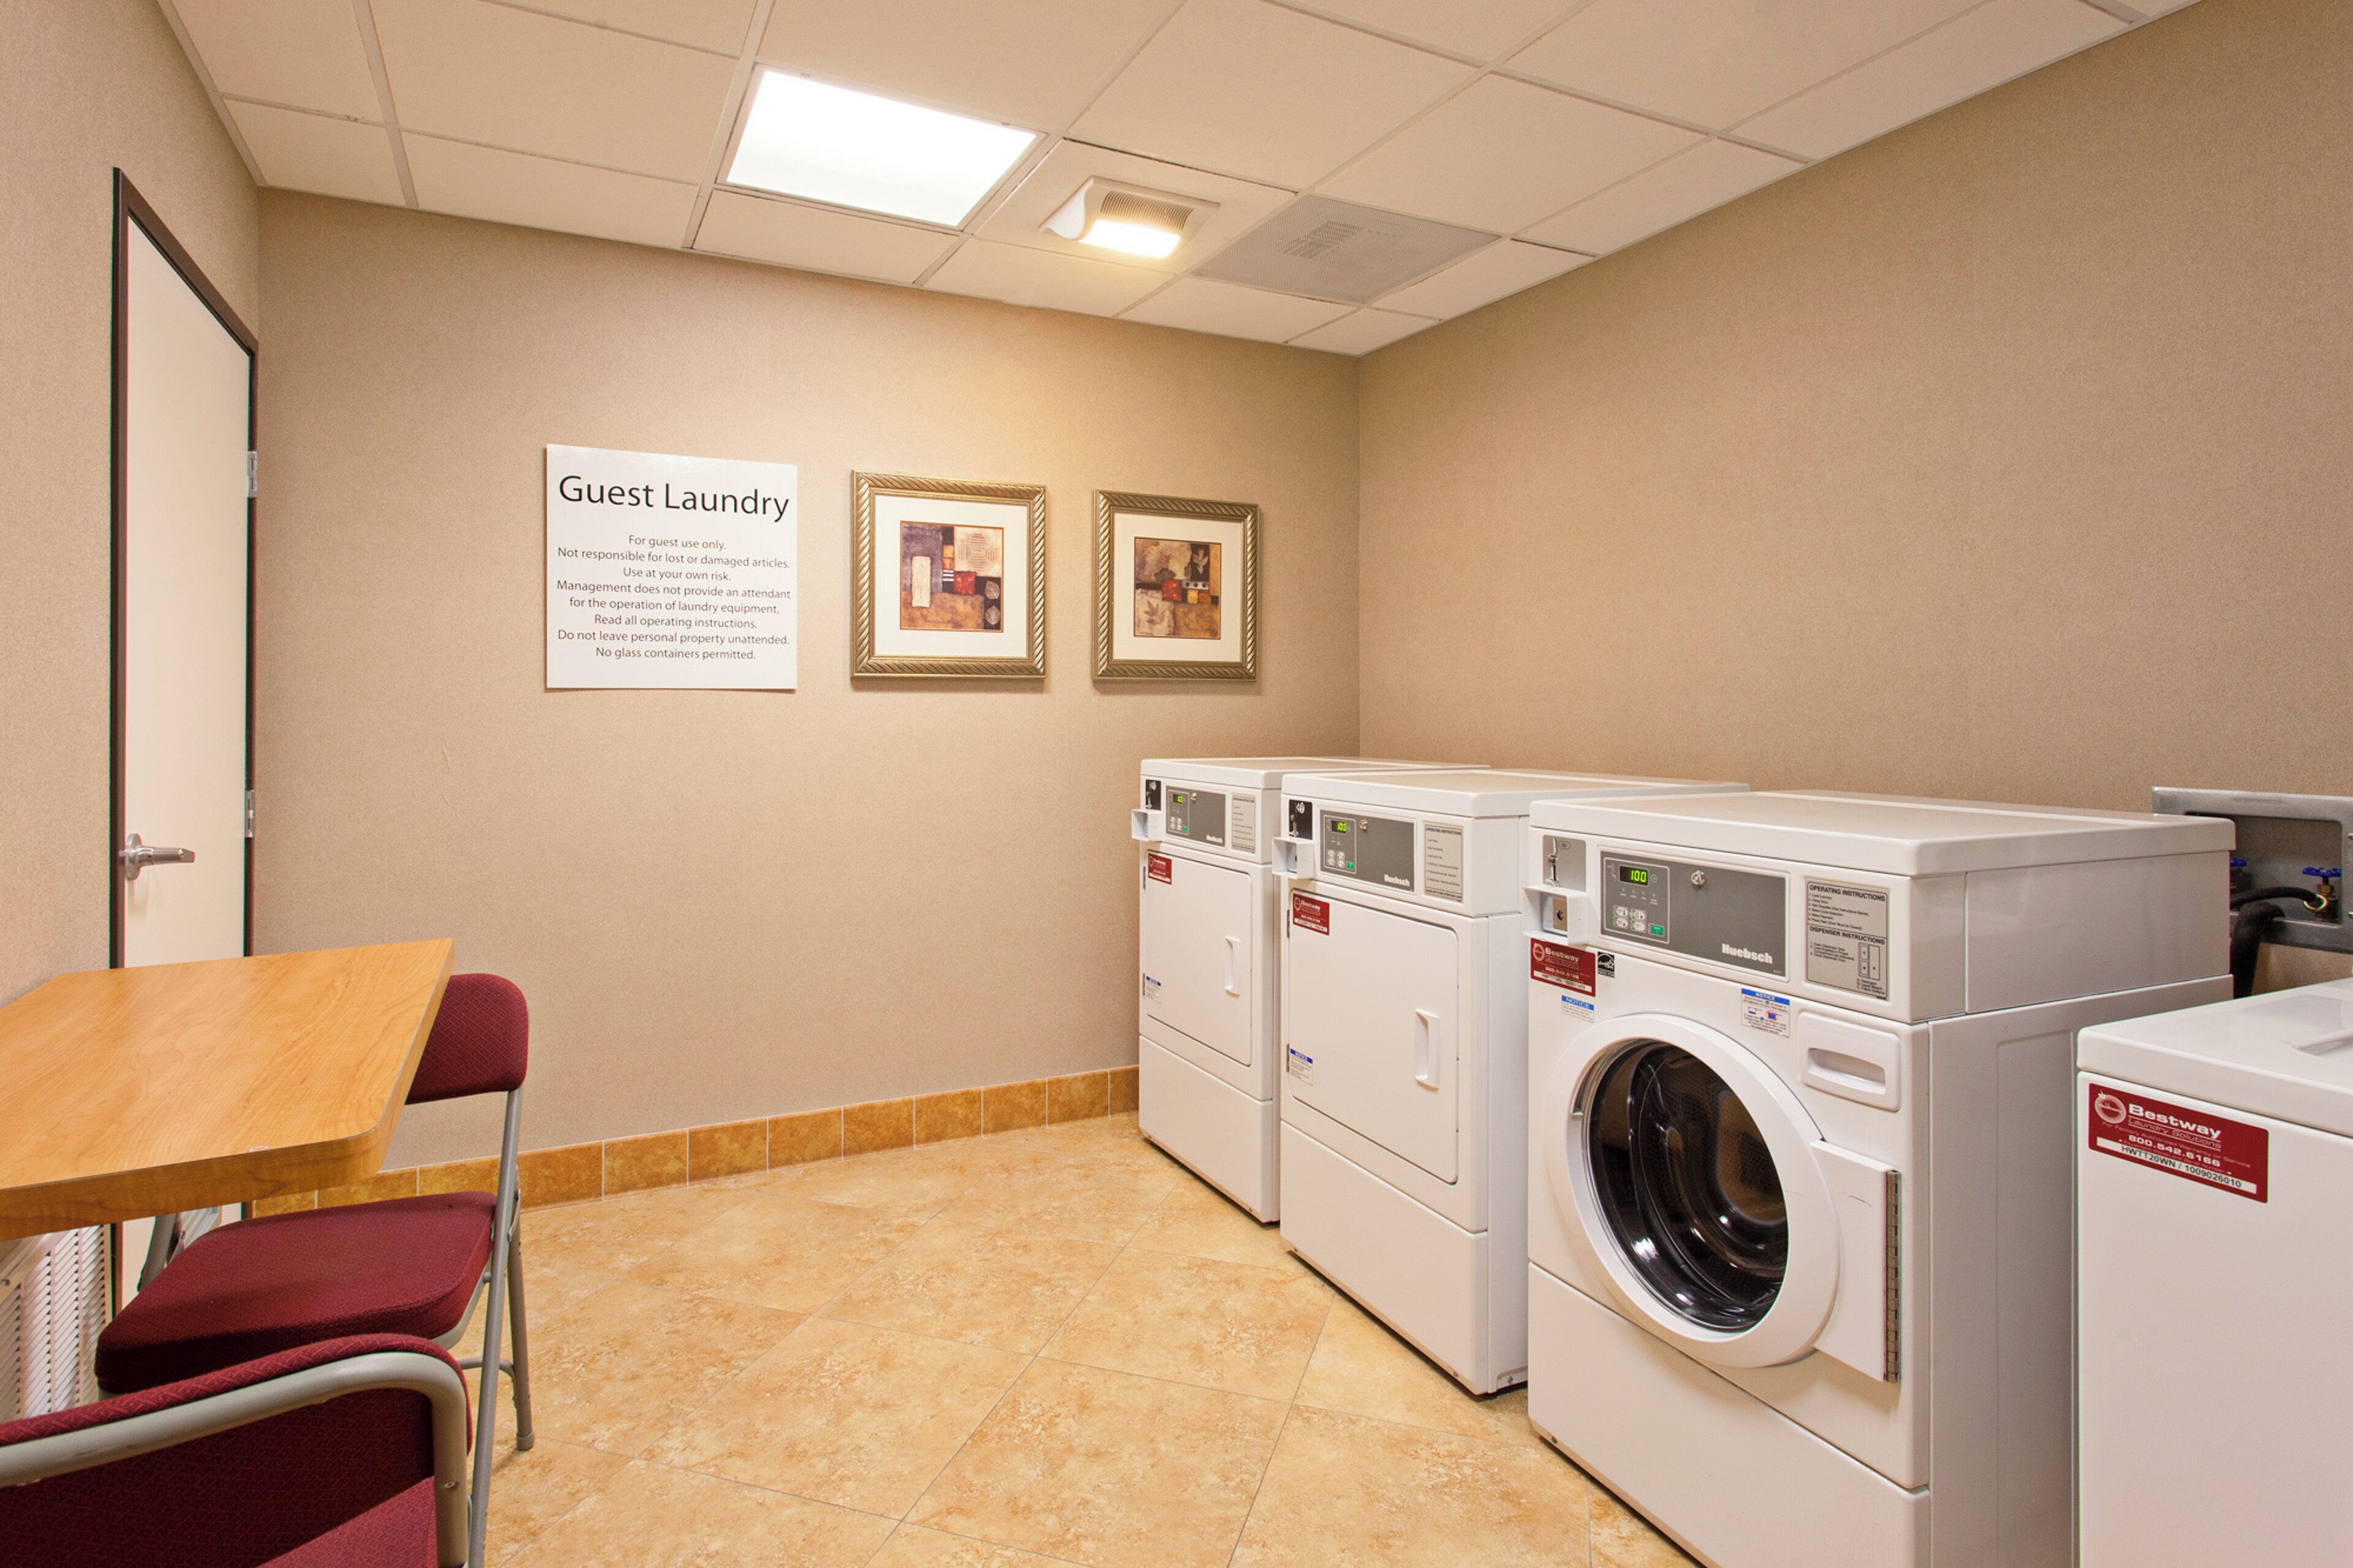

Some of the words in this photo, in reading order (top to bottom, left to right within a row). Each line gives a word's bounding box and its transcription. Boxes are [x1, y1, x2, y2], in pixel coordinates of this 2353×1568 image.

[559, 475, 654, 508] Guest
[665, 483, 789, 523] Laundry
[629, 535, 646, 545] For
[648, 538, 678, 548] guest
[702, 540, 727, 551] only.
[558, 547, 578, 558] Not
[582, 550, 645, 562] responsible
[648, 551, 662, 562] for
[665, 553, 684, 563] lost
[700, 555, 749, 567] damaged
[752, 558, 790, 569] articles.
[623, 567, 643, 577] Use
[645, 569, 656, 578] at
[659, 570, 683, 580] your
[711, 571, 731, 581] risk.
[556, 580, 631, 594] Management
[634, 583, 660, 594] does
[663, 586, 681, 595] not
[684, 586, 724, 597] provide
[741, 589, 790, 599] attendant
[569, 596, 585, 607] for
[588, 597, 607, 608] the
[609, 599, 662, 610] operation
[665, 600, 676, 610] of
[678, 601, 718, 614] laundry
[721, 604, 779, 615] equipment.
[594, 614, 621, 625] Read
[624, 615, 637, 625] all
[640, 616, 692, 629] operating
[695, 617, 757, 629] instructions.
[558, 629, 574, 640] Do
[577, 631, 596, 640] not
[599, 631, 627, 641] leave
[631, 632, 677, 643] personal
[680, 634, 725, 645] property
[728, 635, 790, 645] unattended.
[596, 647, 612, 657] No
[615, 648, 642, 659] glass
[644, 649, 700, 659] containers
[702, 650, 756, 660] permitted.
[1631, 870, 1646, 883] 100
[1809, 884, 1841, 895] OPERATING
[1842, 890, 1885, 902] INSTRUCTIONS
[1809, 926, 1841, 937] DISPENSER
[1842, 931, 1885, 945] INSTRUCTIONS
[1545, 947, 1579, 963] Bestway
[1722, 943, 1773, 964] Huebsch
[2129, 1103, 2221, 1139] Bestway
[2128, 1118, 2170, 1134] Laundry
[2172, 1129, 2221, 1148] Solutions
[2184, 1165, 2242, 1187] 1009026010
